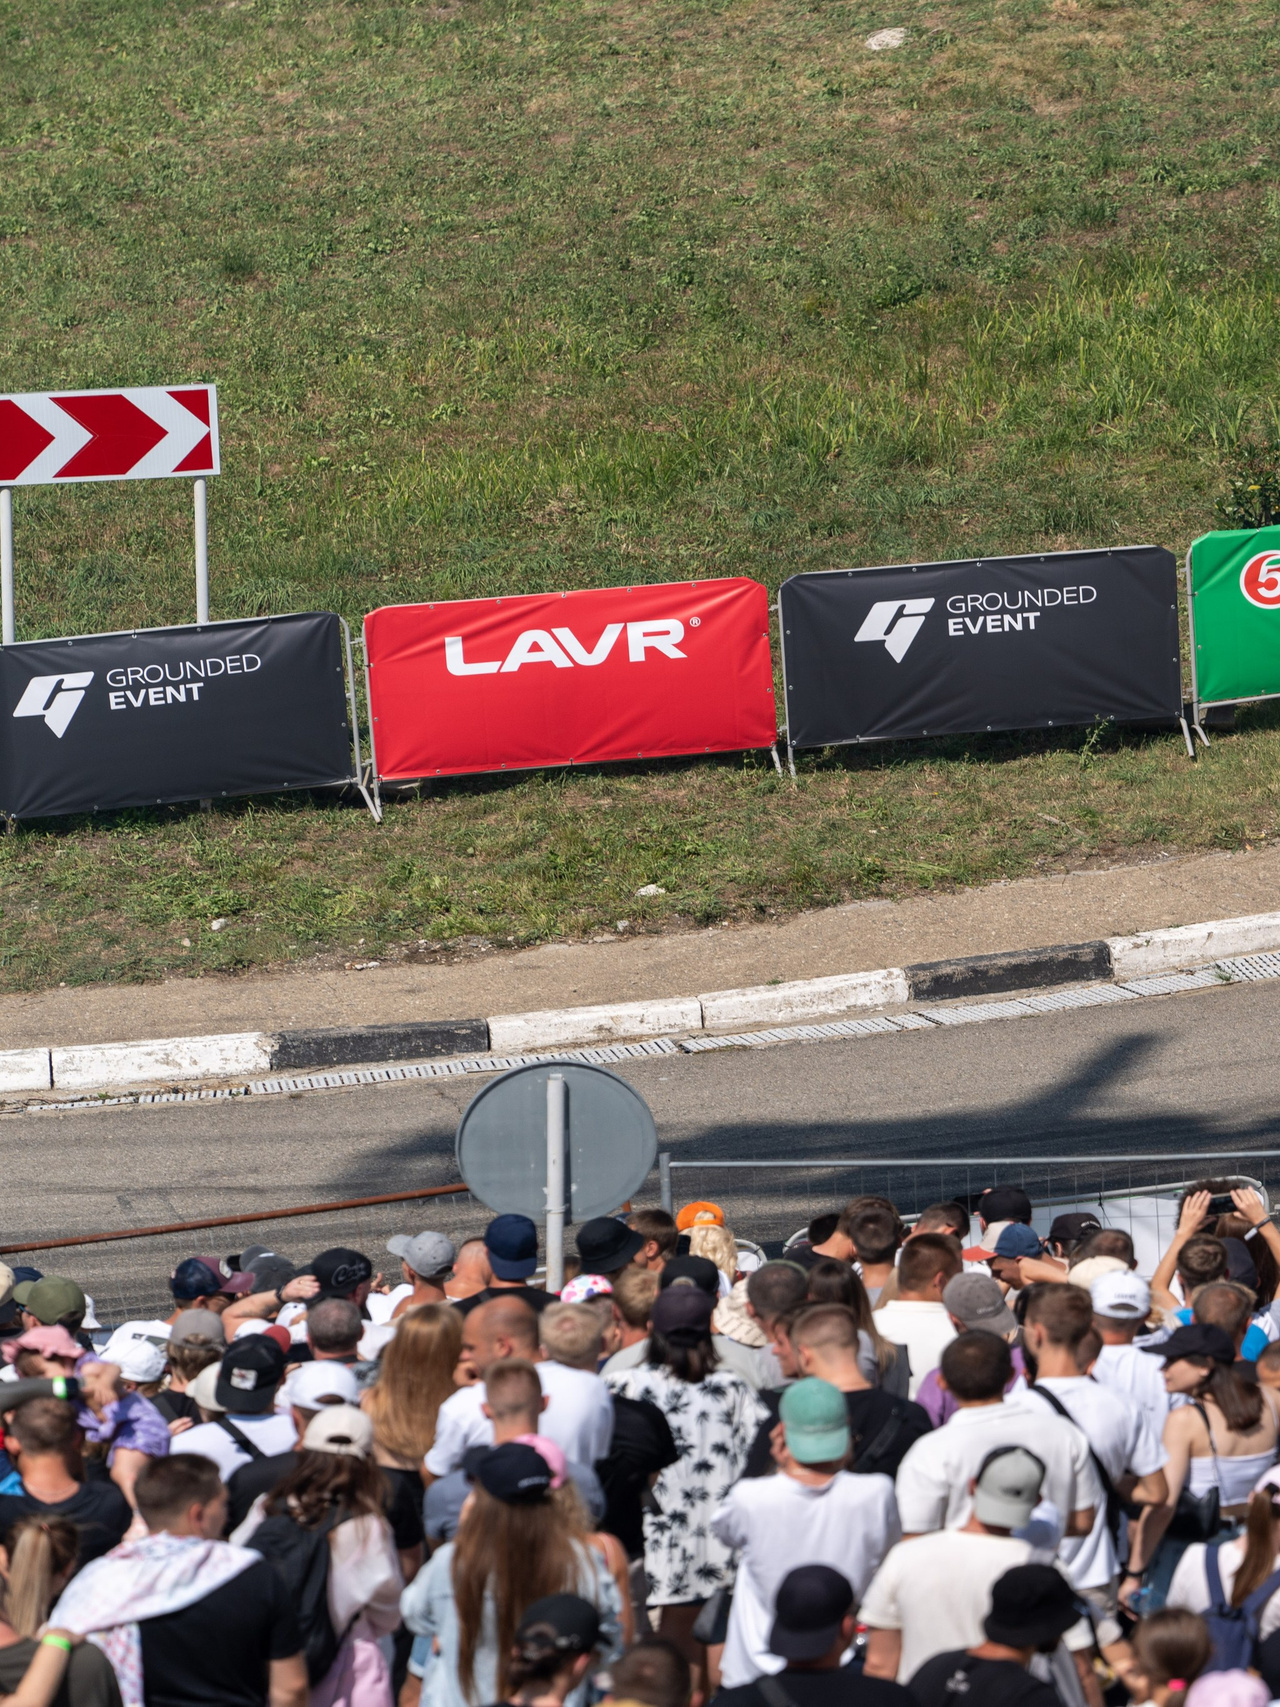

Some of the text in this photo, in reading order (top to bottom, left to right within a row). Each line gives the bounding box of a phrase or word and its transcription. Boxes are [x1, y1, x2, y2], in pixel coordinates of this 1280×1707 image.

[946, 585, 1097, 614] GROUNDED
[948, 611, 1041, 637] EVENT
[106, 653, 262, 688] GROUNDED
[109, 682, 204, 711] EVENT
